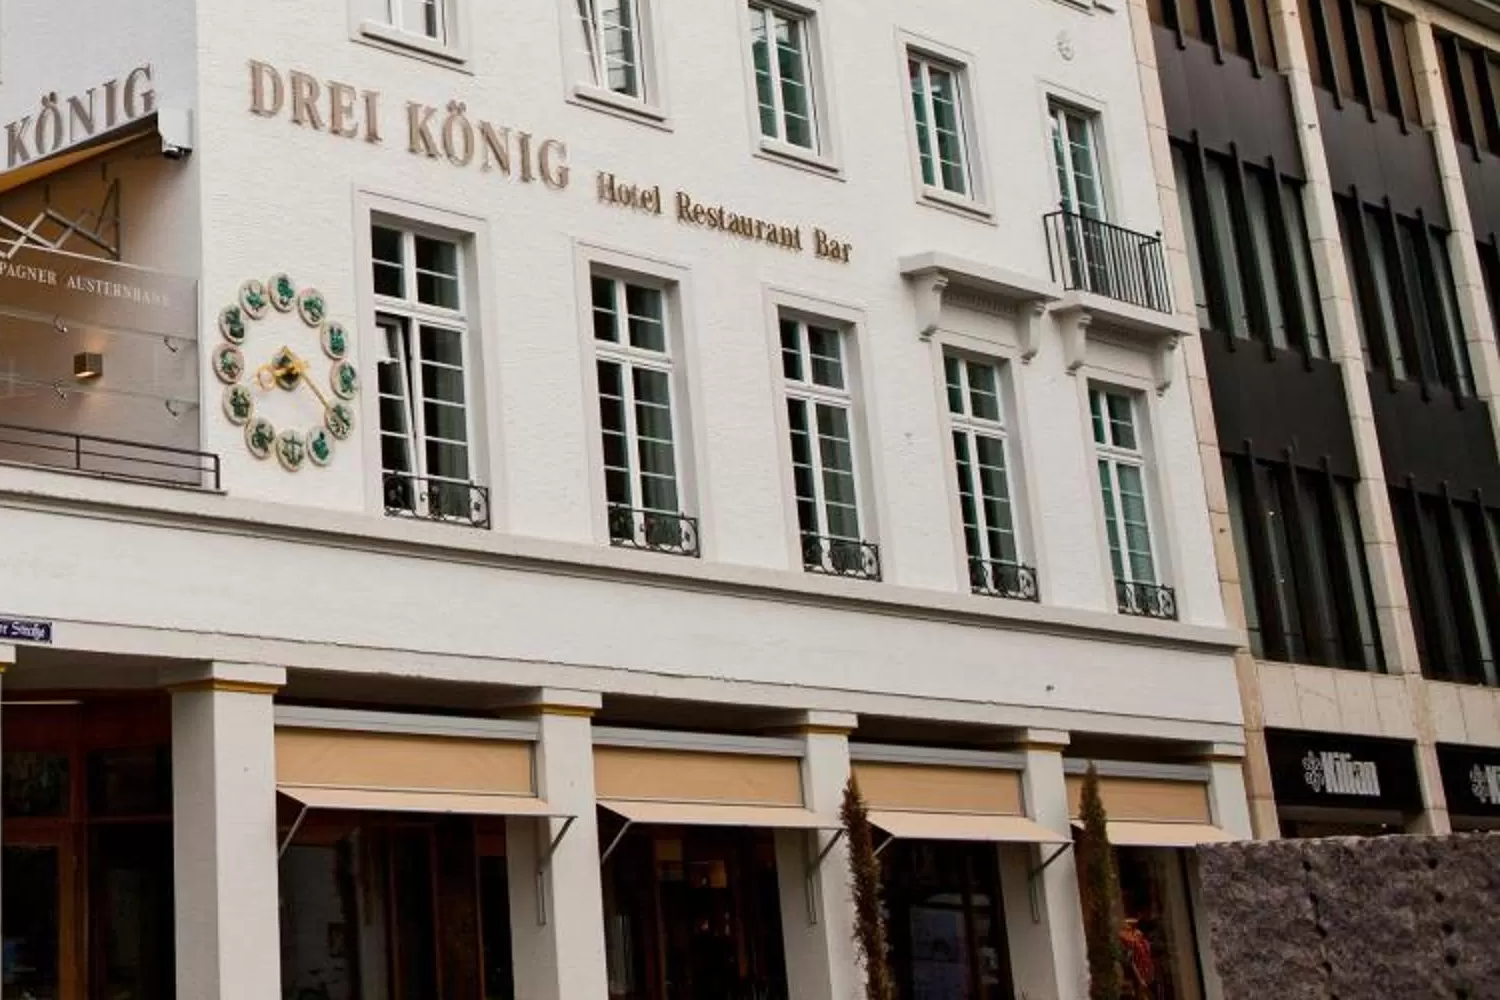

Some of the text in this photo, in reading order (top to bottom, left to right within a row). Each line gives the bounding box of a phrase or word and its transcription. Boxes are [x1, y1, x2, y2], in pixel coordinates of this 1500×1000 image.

[4, 63, 155, 169] KÖNIG
[248, 60, 852, 263] DREI KÖNIG Hotel Restaurant Bar
[1320, 750, 1381, 797] Kilian
